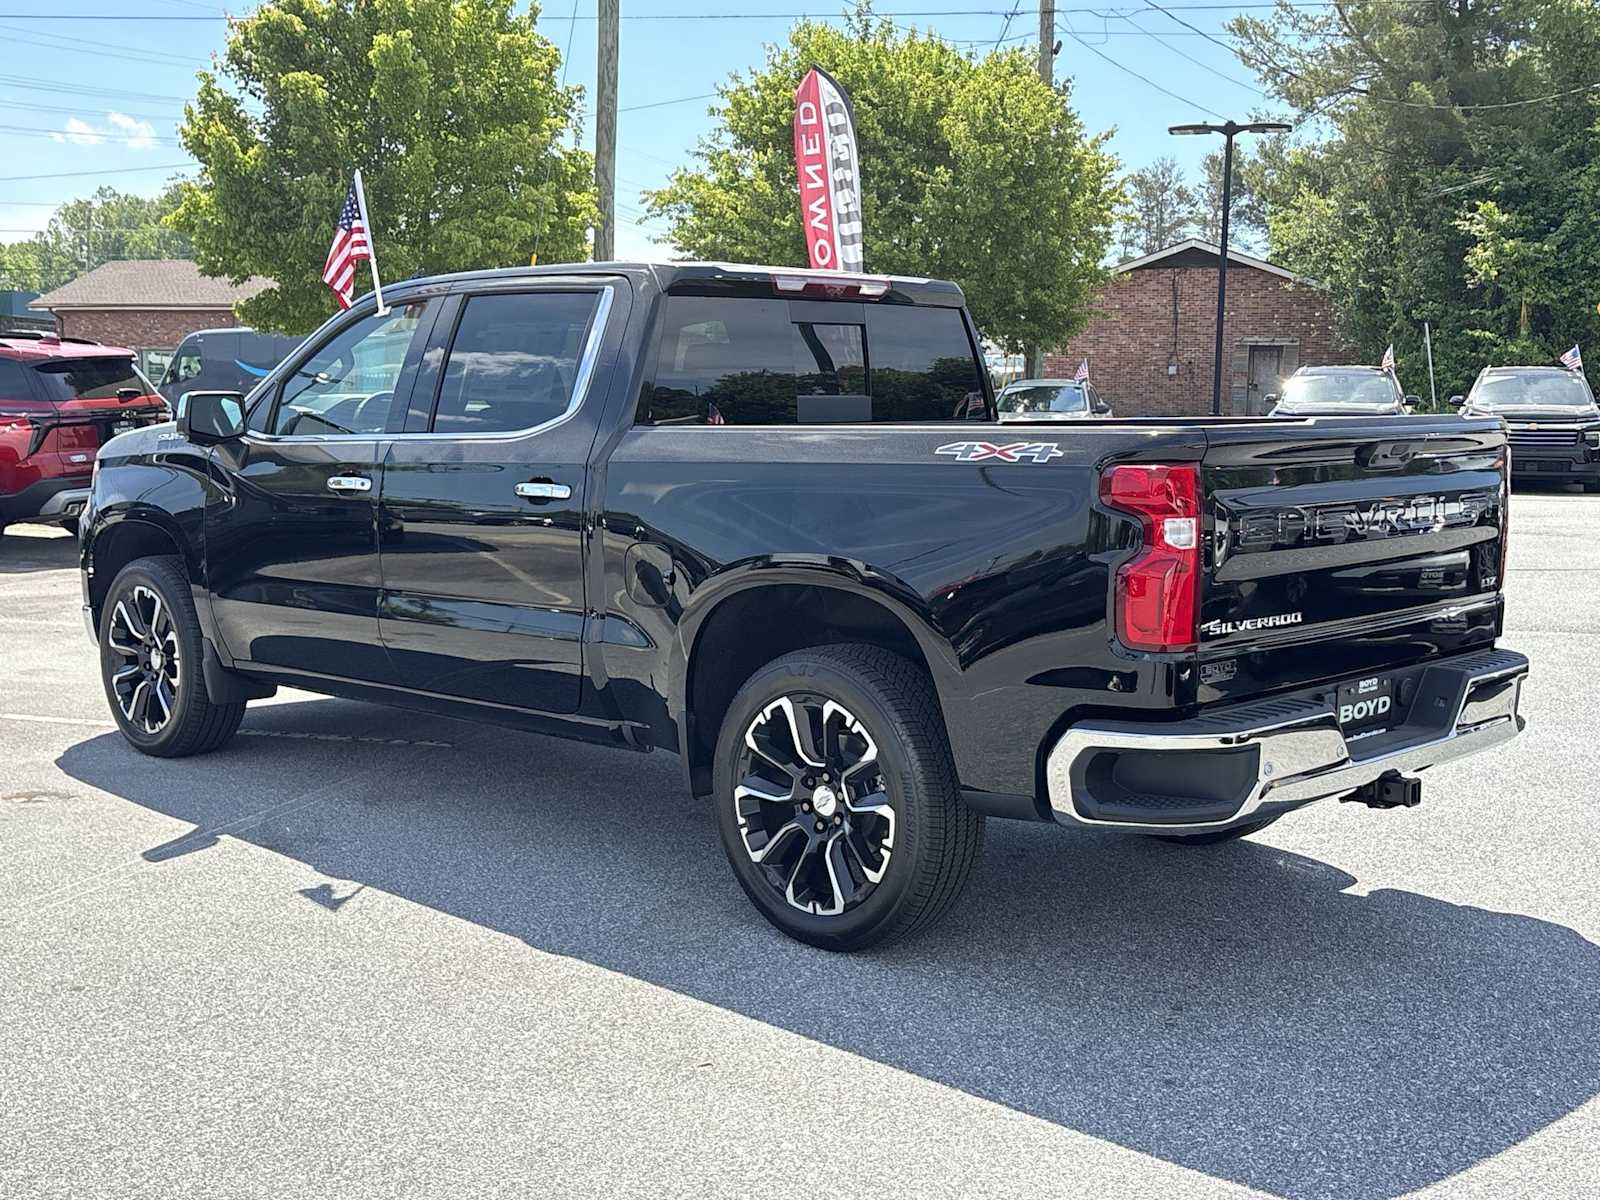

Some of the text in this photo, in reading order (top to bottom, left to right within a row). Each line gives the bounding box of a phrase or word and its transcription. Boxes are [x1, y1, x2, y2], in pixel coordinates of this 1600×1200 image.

[1201, 612, 1303, 636] SILVERADO
[1359, 677, 1378, 688] BOYD
[1339, 695, 1391, 724] BOYD
